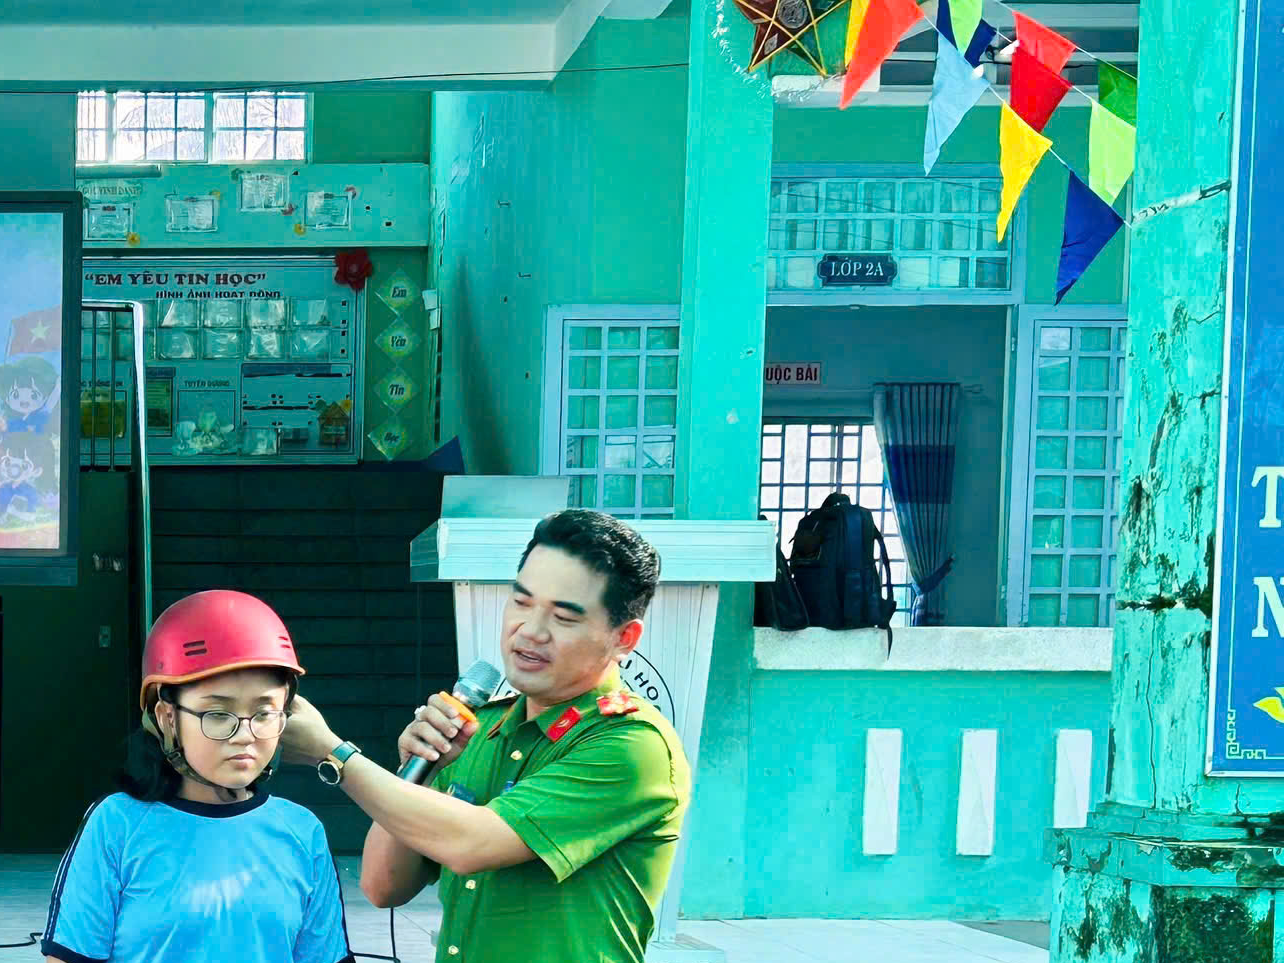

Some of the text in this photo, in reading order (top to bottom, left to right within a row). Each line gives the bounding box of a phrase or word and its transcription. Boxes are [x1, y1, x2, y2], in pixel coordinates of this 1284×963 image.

[830, 257, 884, 276] LỚP 2A
[128, 270, 168, 286] YÊU
[174, 273, 208, 286] TIN
[392, 287, 407, 299] Em
[766, 364, 818, 384] UỘC BÀI
